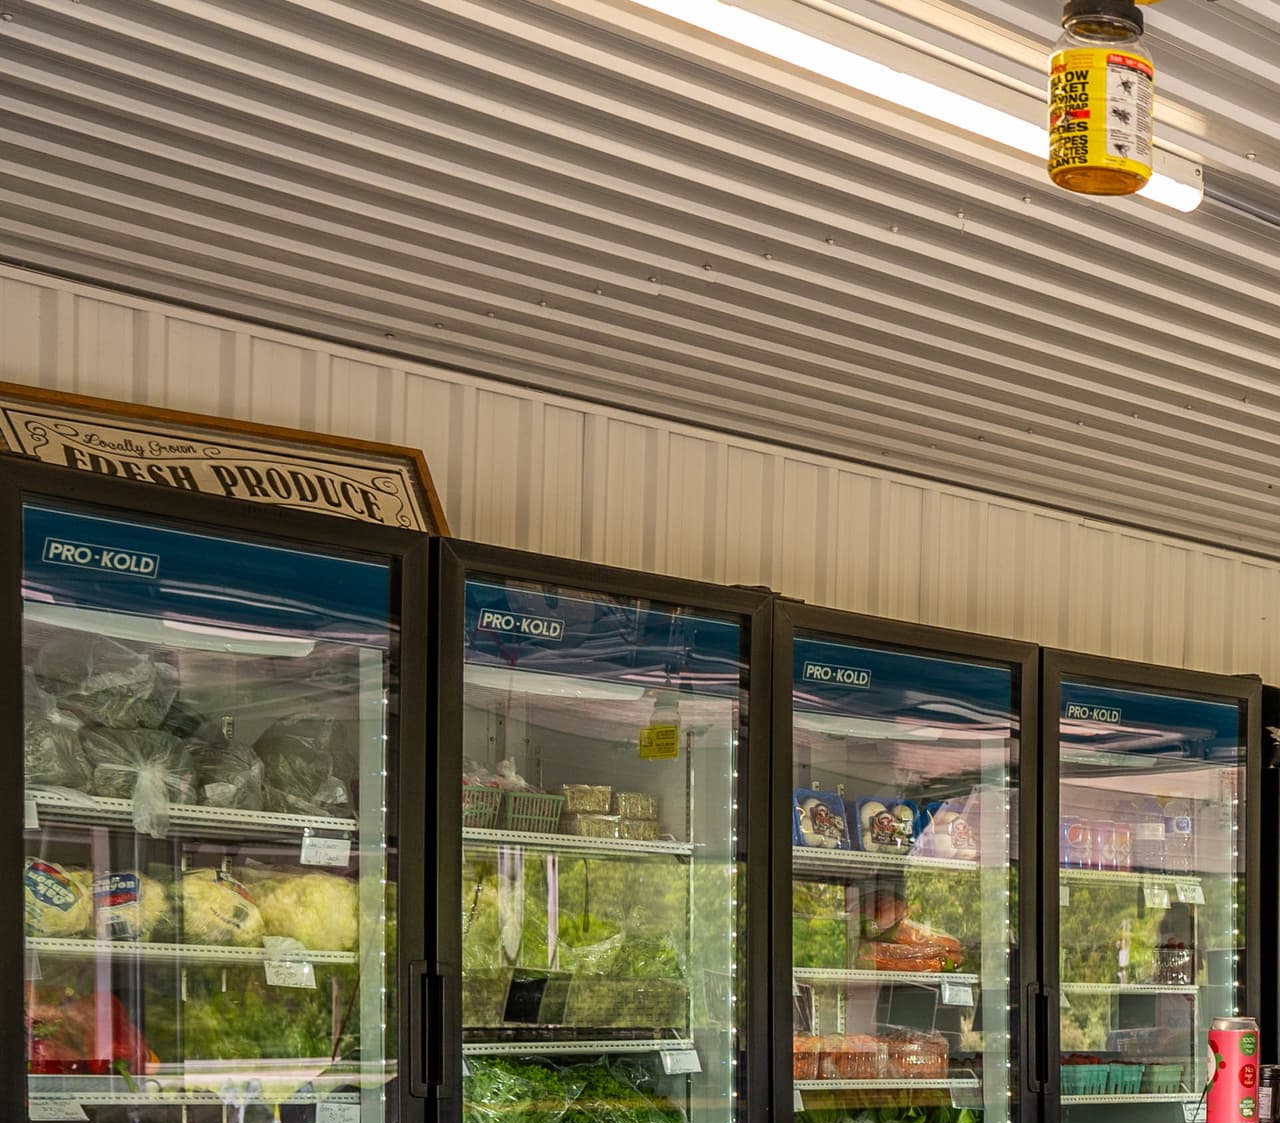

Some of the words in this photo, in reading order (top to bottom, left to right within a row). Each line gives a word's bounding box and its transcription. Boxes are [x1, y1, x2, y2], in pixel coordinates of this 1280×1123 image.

[82, 432, 145, 457] Locally
[148, 439, 197, 457] Grown
[211, 463, 384, 523] PRODUCE
